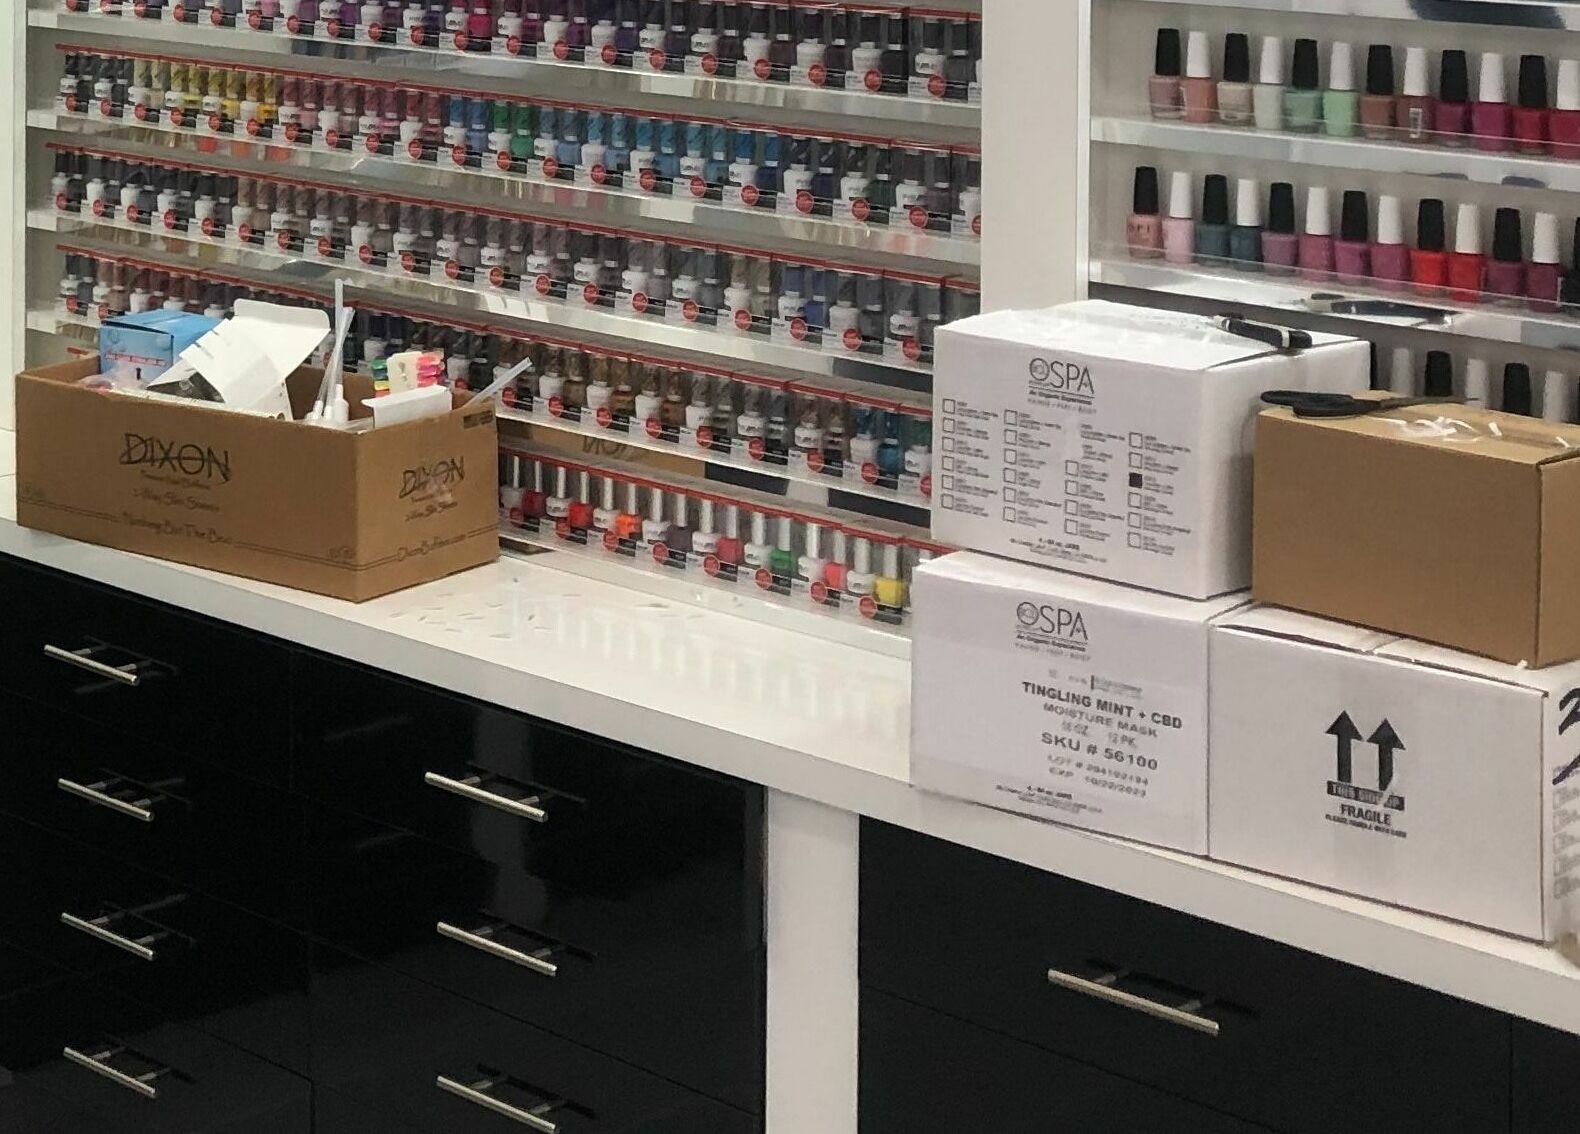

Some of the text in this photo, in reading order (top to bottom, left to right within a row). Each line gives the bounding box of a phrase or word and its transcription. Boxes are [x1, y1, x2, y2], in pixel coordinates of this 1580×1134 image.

[118, 432, 233, 483] DIXON
[1021, 680, 1092, 709] TINGLING
[1095, 698, 1134, 719] MINT
[1150, 712, 1183, 730] CBD
[1043, 702, 1158, 738] MOISTURE MASK
[1041, 731, 1159, 771] SKU # 56100
[1340, 803, 1392, 826] FRAGILE
